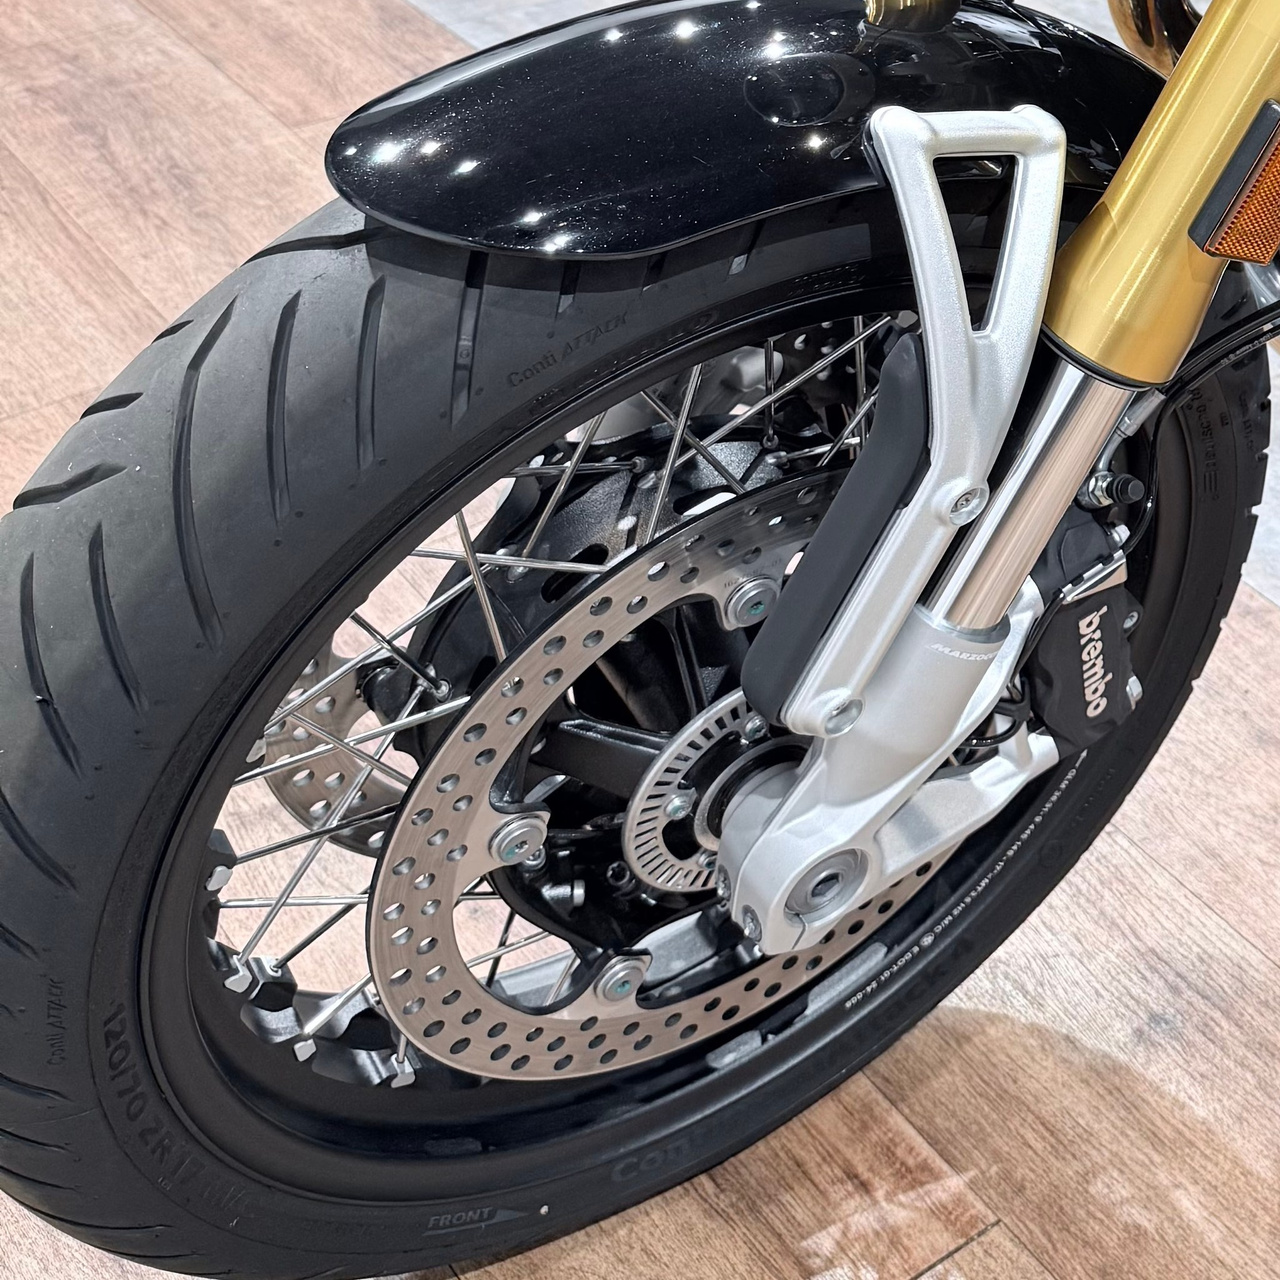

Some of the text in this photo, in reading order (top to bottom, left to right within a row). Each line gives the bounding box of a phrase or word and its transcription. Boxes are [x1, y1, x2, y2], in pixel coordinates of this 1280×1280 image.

[1078, 605, 1114, 719] brembo
[103, 1002, 148, 1122] 120/70
[427, 1206, 494, 1229] FRONT
